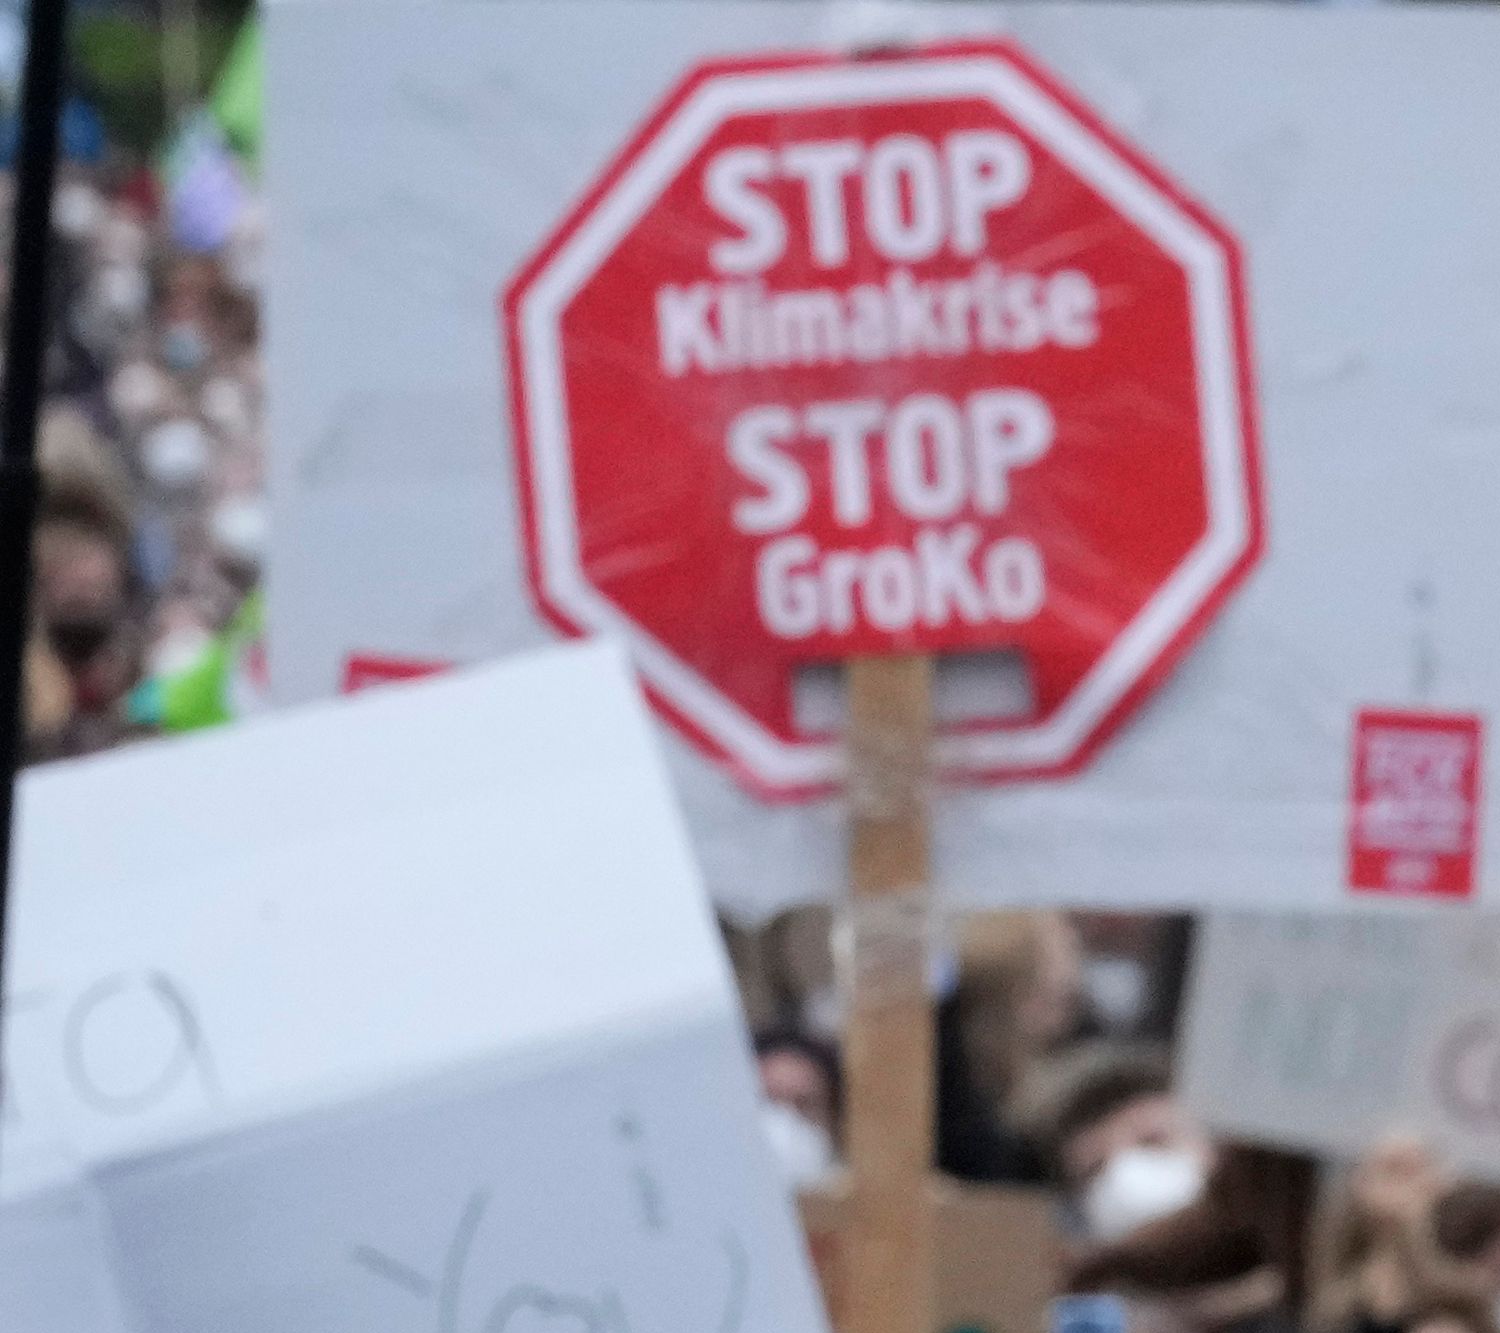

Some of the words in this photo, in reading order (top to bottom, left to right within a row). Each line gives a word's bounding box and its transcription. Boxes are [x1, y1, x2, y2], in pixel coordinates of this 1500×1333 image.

[703, 128, 1032, 276] STOP
[655, 263, 1102, 380] Klimakrise
[724, 386, 1057, 538] STOP
[755, 522, 1046, 642] GroKo
